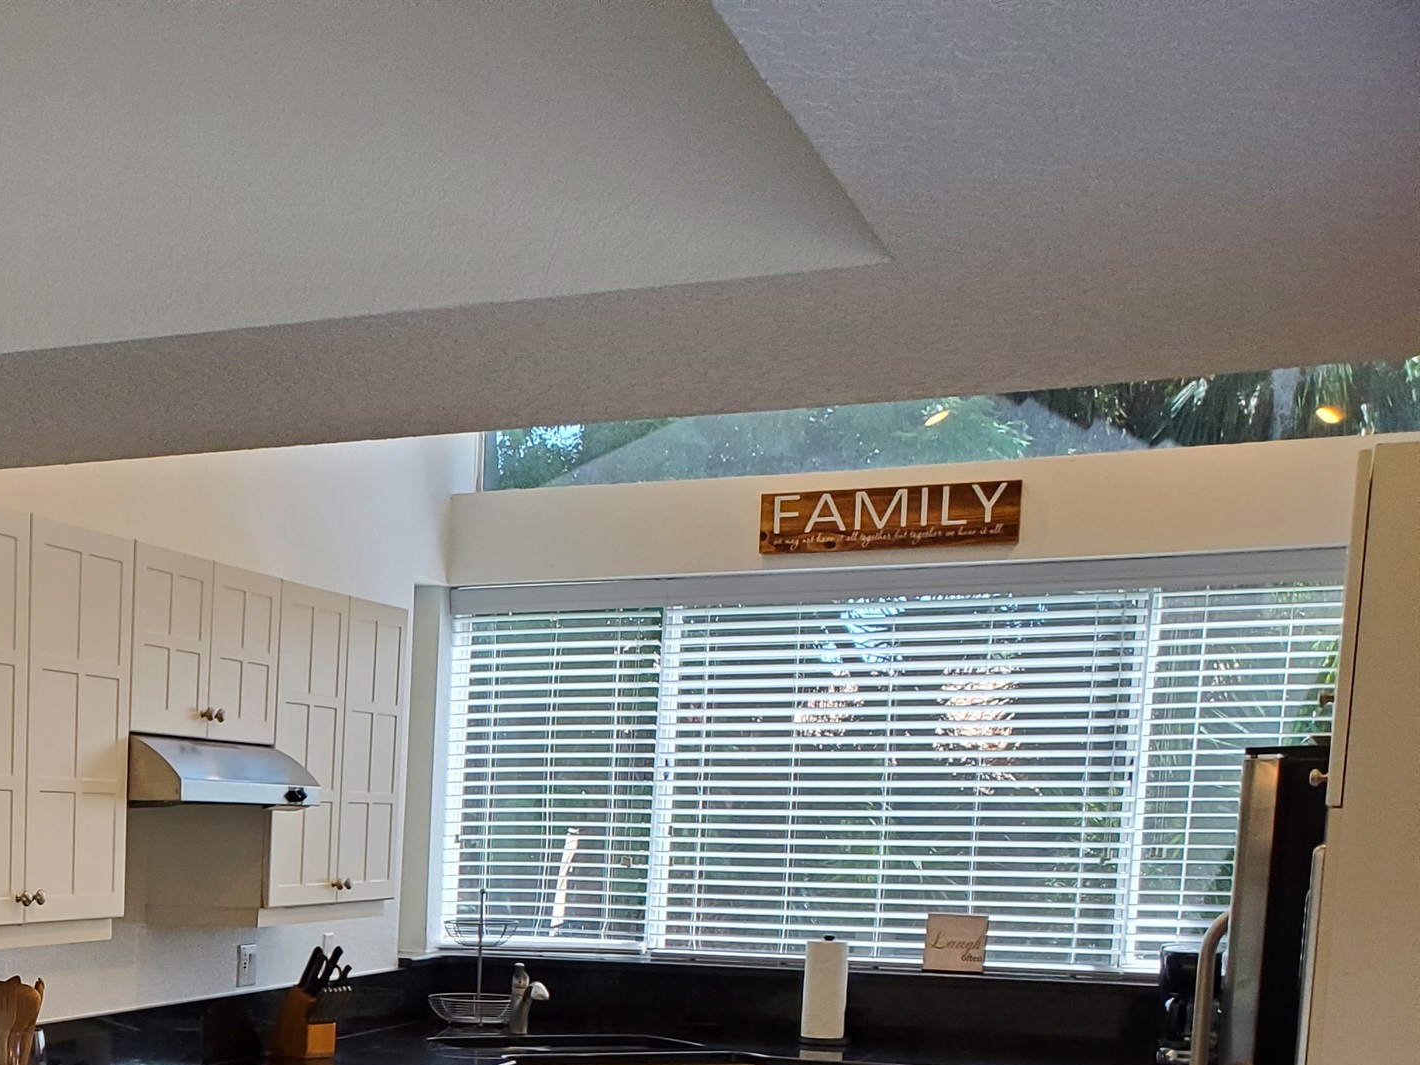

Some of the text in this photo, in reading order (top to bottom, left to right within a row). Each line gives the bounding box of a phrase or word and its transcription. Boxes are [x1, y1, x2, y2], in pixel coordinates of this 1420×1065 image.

[773, 482, 1008, 535] FAMILY
[846, 530, 859, 541] all
[909, 526, 941, 545] together
[957, 525, 976, 536] have
[979, 526, 988, 535] it
[929, 930, 984, 956] Laugh
[960, 953, 983, 963] often
